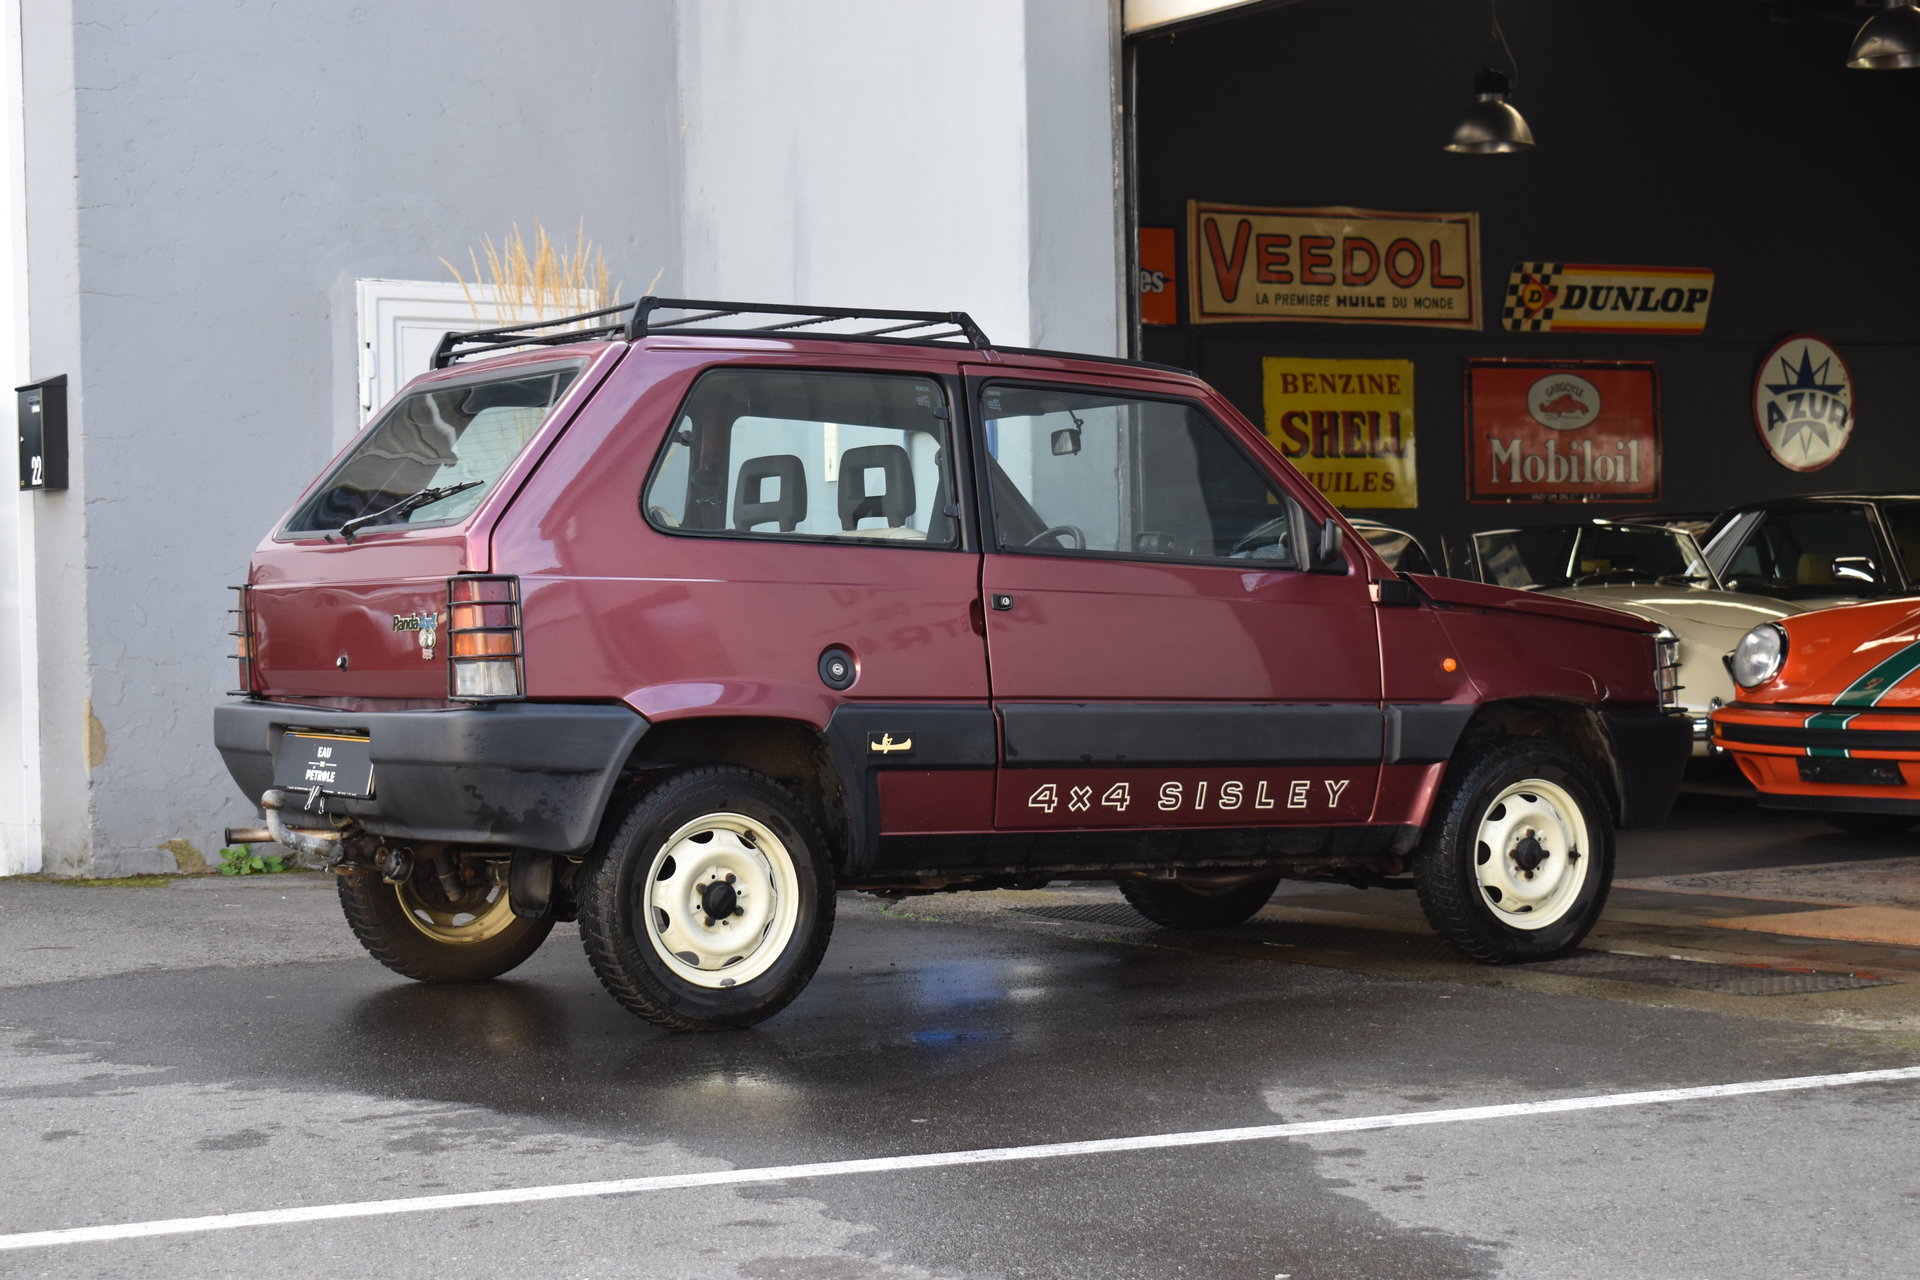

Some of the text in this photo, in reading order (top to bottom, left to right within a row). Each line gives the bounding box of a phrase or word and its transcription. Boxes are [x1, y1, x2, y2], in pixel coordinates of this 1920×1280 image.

[1203, 217, 1465, 304] VEEDOL
[1255, 292, 1269, 305] LA
[1336, 294, 1386, 309] HUILE
[1392, 296, 1408, 309] DU
[1413, 296, 1454, 310] MONDE
[1528, 290, 1542, 303] D
[1560, 285, 1709, 313] DUNLOP
[1280, 373, 1400, 395] BENZINE
[1766, 391, 1849, 432] AZUR
[1280, 410, 1409, 459] SHELL
[31, 455, 43, 486] 22
[1490, 438, 1639, 483] Mobiloil
[317, 746, 332, 759] EAU
[305, 765, 336, 783] PÉTROLE
[1028, 779, 1350, 813] 4x4 SISLEY
